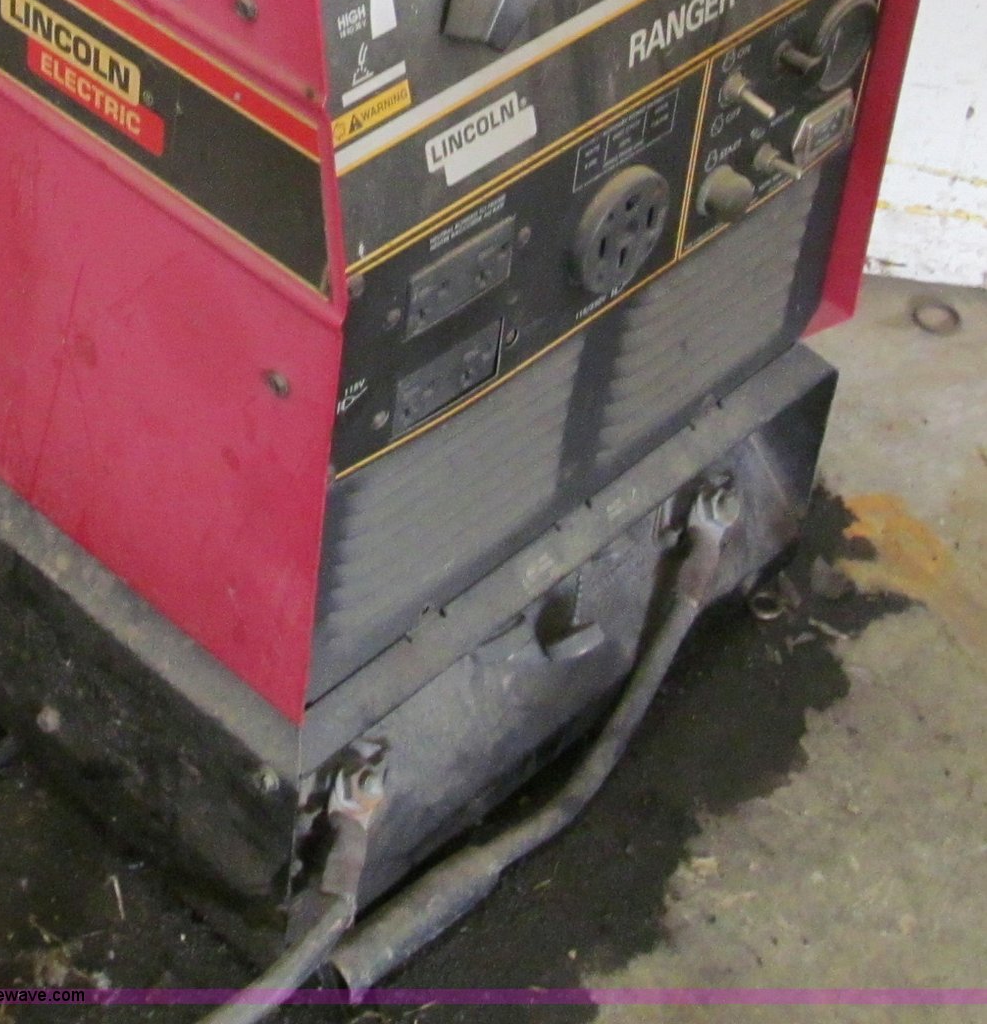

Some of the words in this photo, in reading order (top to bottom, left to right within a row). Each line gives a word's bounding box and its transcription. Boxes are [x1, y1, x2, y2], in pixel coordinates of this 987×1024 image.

[337, 3, 367, 32] HIGH
[40, 51, 142, 136] ELECTRIC
[360, 90, 408, 123] WARNING
[430, 99, 515, 164] LINCOLN
